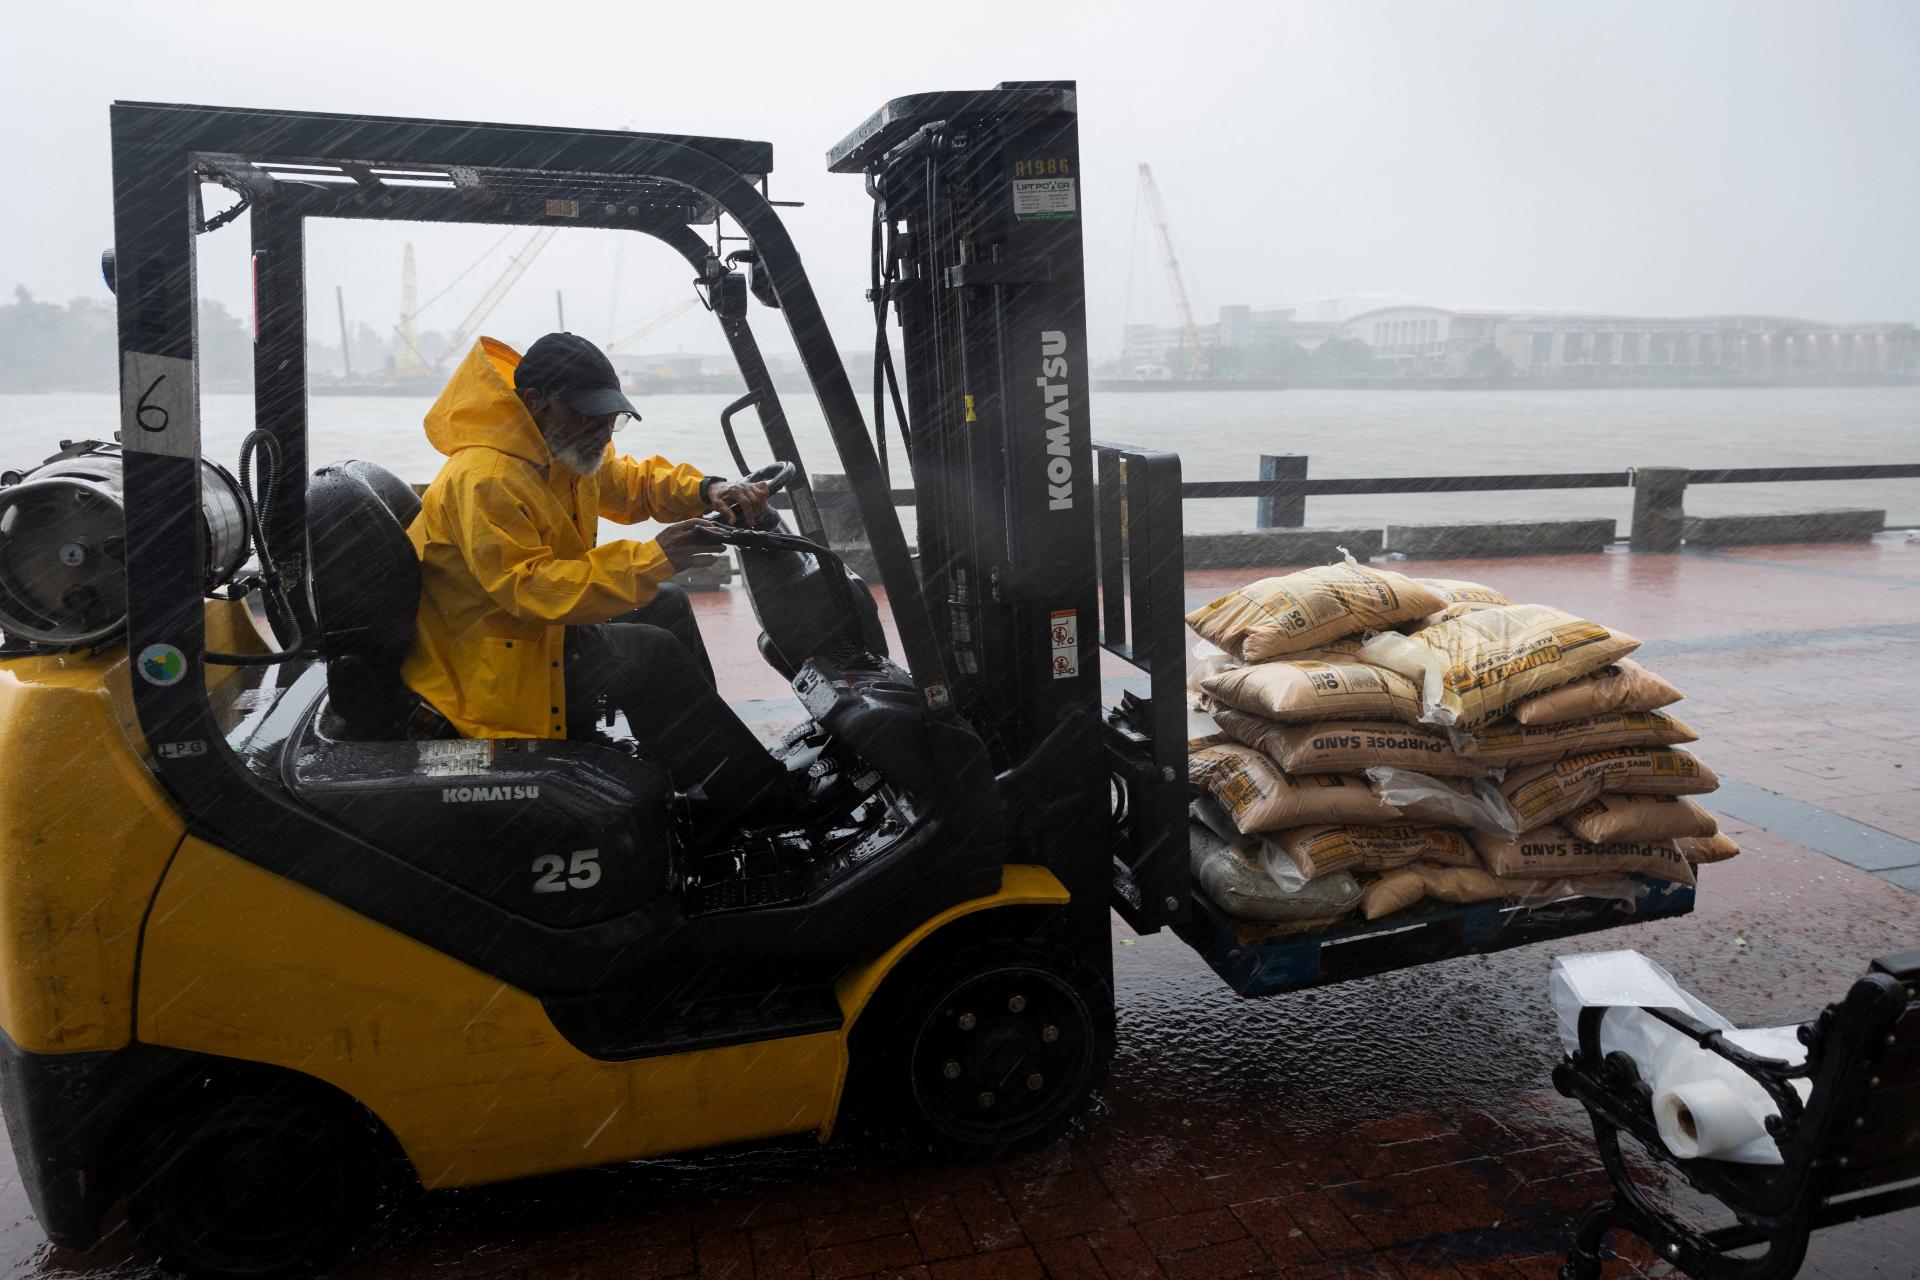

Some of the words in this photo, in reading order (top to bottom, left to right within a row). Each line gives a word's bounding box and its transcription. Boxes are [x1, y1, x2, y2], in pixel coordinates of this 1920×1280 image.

[136, 374, 168, 432] 6
[1036, 330, 1073, 511] KOMATSU
[1288, 610, 1306, 628] 50
[1320, 673, 1339, 690] 50
[1312, 735, 1361, 750] SAND
[1679, 758, 1694, 768] 50
[1563, 762, 1625, 788] ALL-PURPOSE
[1627, 760, 1652, 768] SAND
[442, 785, 540, 803] KOMATSU
[1520, 843, 1567, 857] SAND
[531, 847, 602, 894] 25
